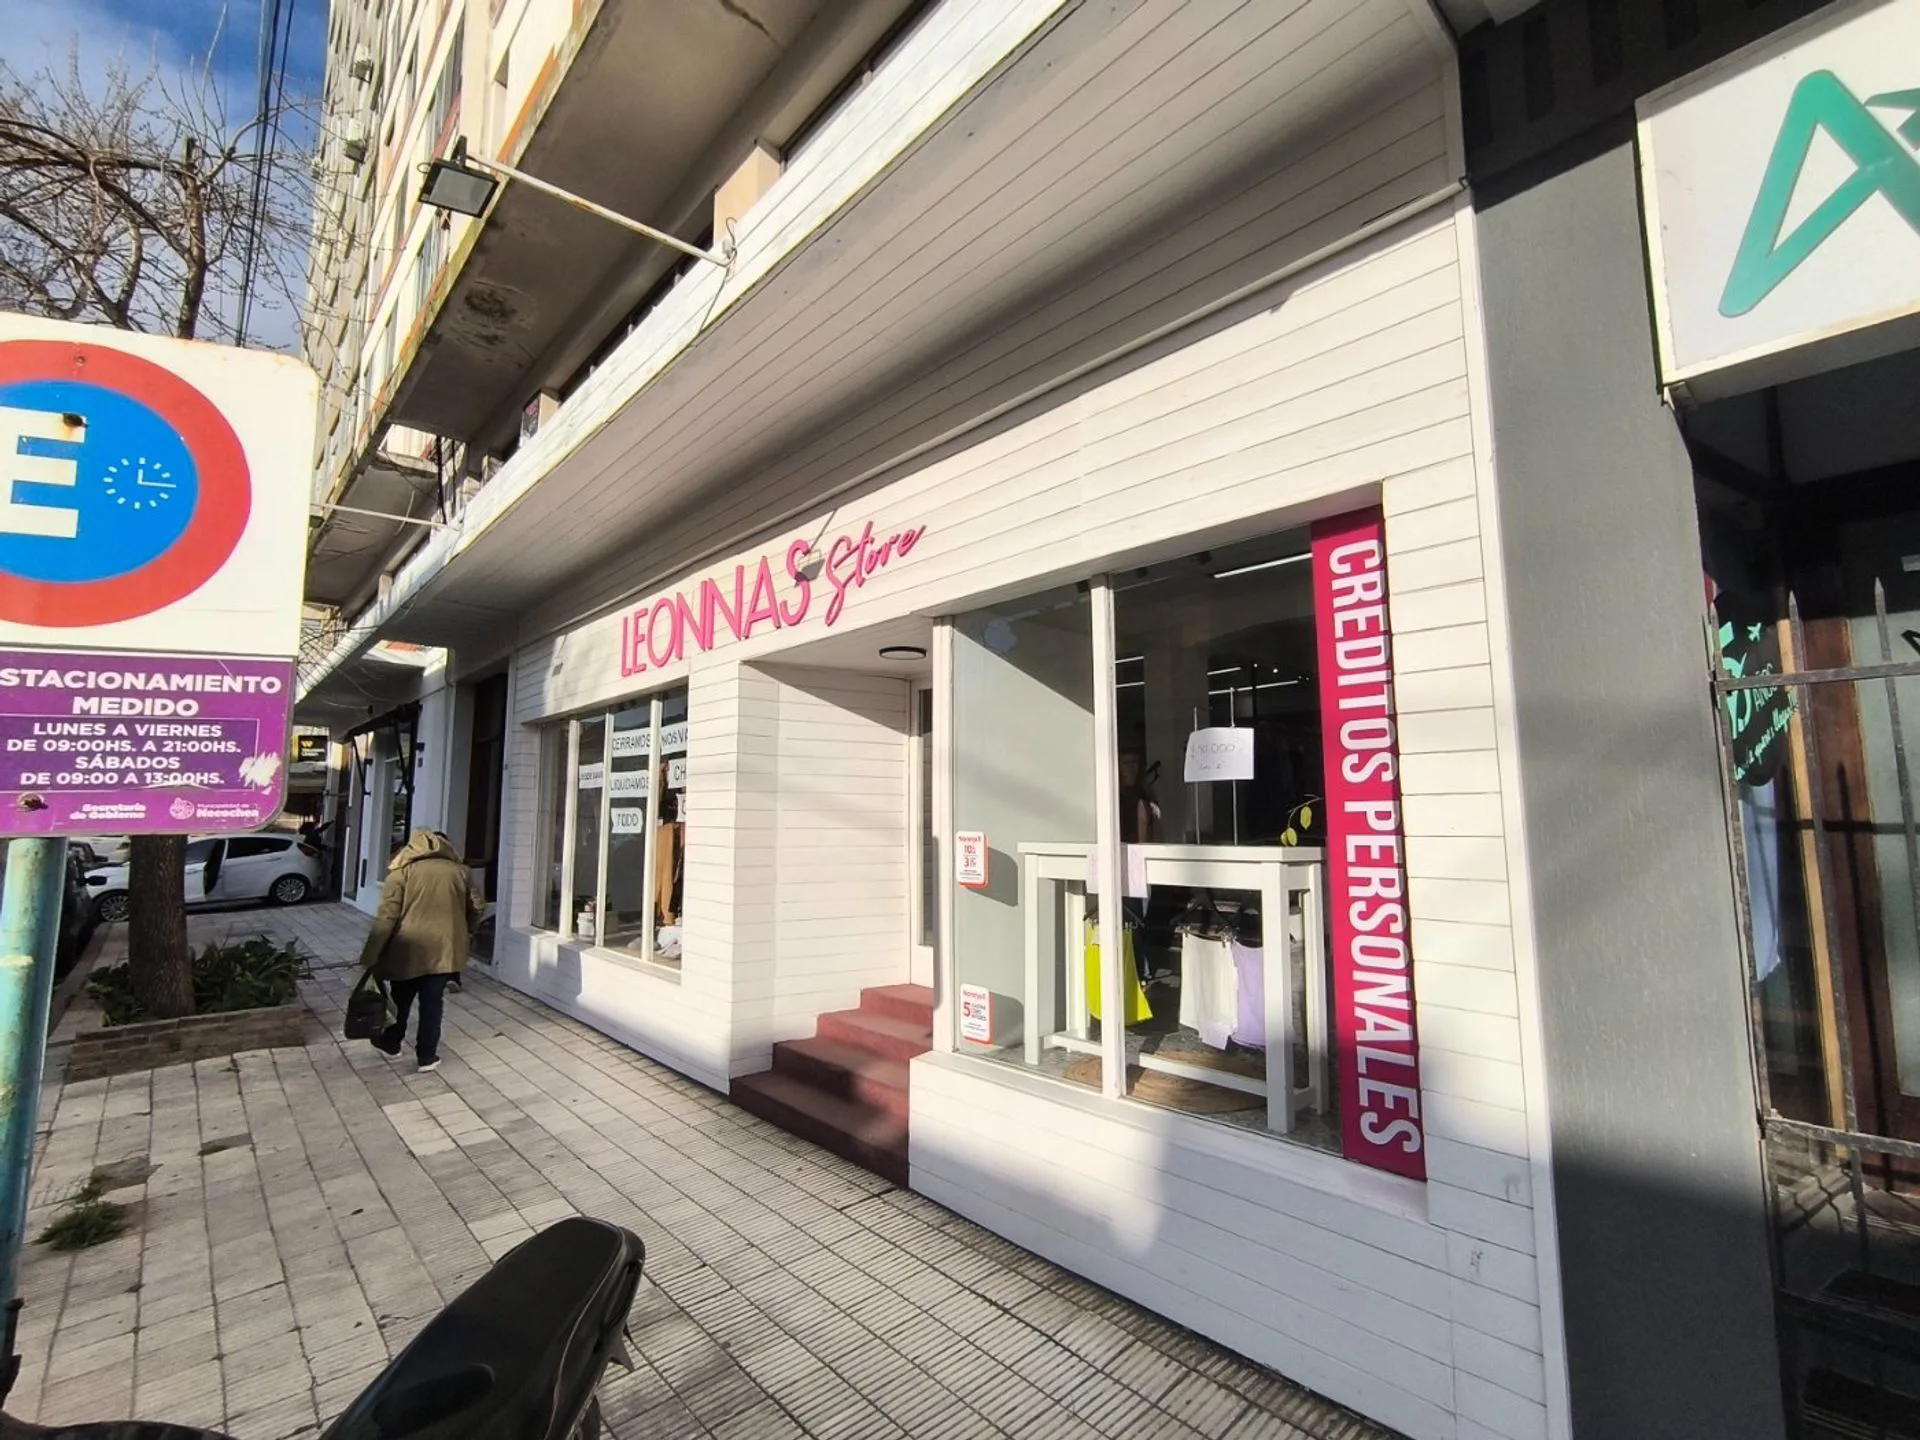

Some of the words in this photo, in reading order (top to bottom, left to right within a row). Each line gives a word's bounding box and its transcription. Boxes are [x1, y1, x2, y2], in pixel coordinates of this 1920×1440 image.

[0, 406, 87, 538] E
[621, 539, 812, 677] LEONNAS
[825, 520, 927, 627] Store
[1328, 538, 1398, 784] CREDITOS
[72, 696, 199, 717] MEDIDO
[34, 722, 106, 736] LUNES
[113, 723, 129, 737] A
[135, 723, 222, 737] VIERNES
[7, 739, 36, 752] DE
[43, 740, 136, 752] 09:00HS.
[142, 740, 157, 752] A
[163, 740, 241, 753] 21:00HS.
[75, 753, 181, 769] SÁBADOS
[20, 772, 50, 785] DE
[56, 772, 118, 785] 09:00
[123, 772, 139, 785] A
[144, 772, 224, 785] 13:00HS.
[617, 813, 639, 827] TODO
[1343, 800, 1421, 1154] PERSONALES
